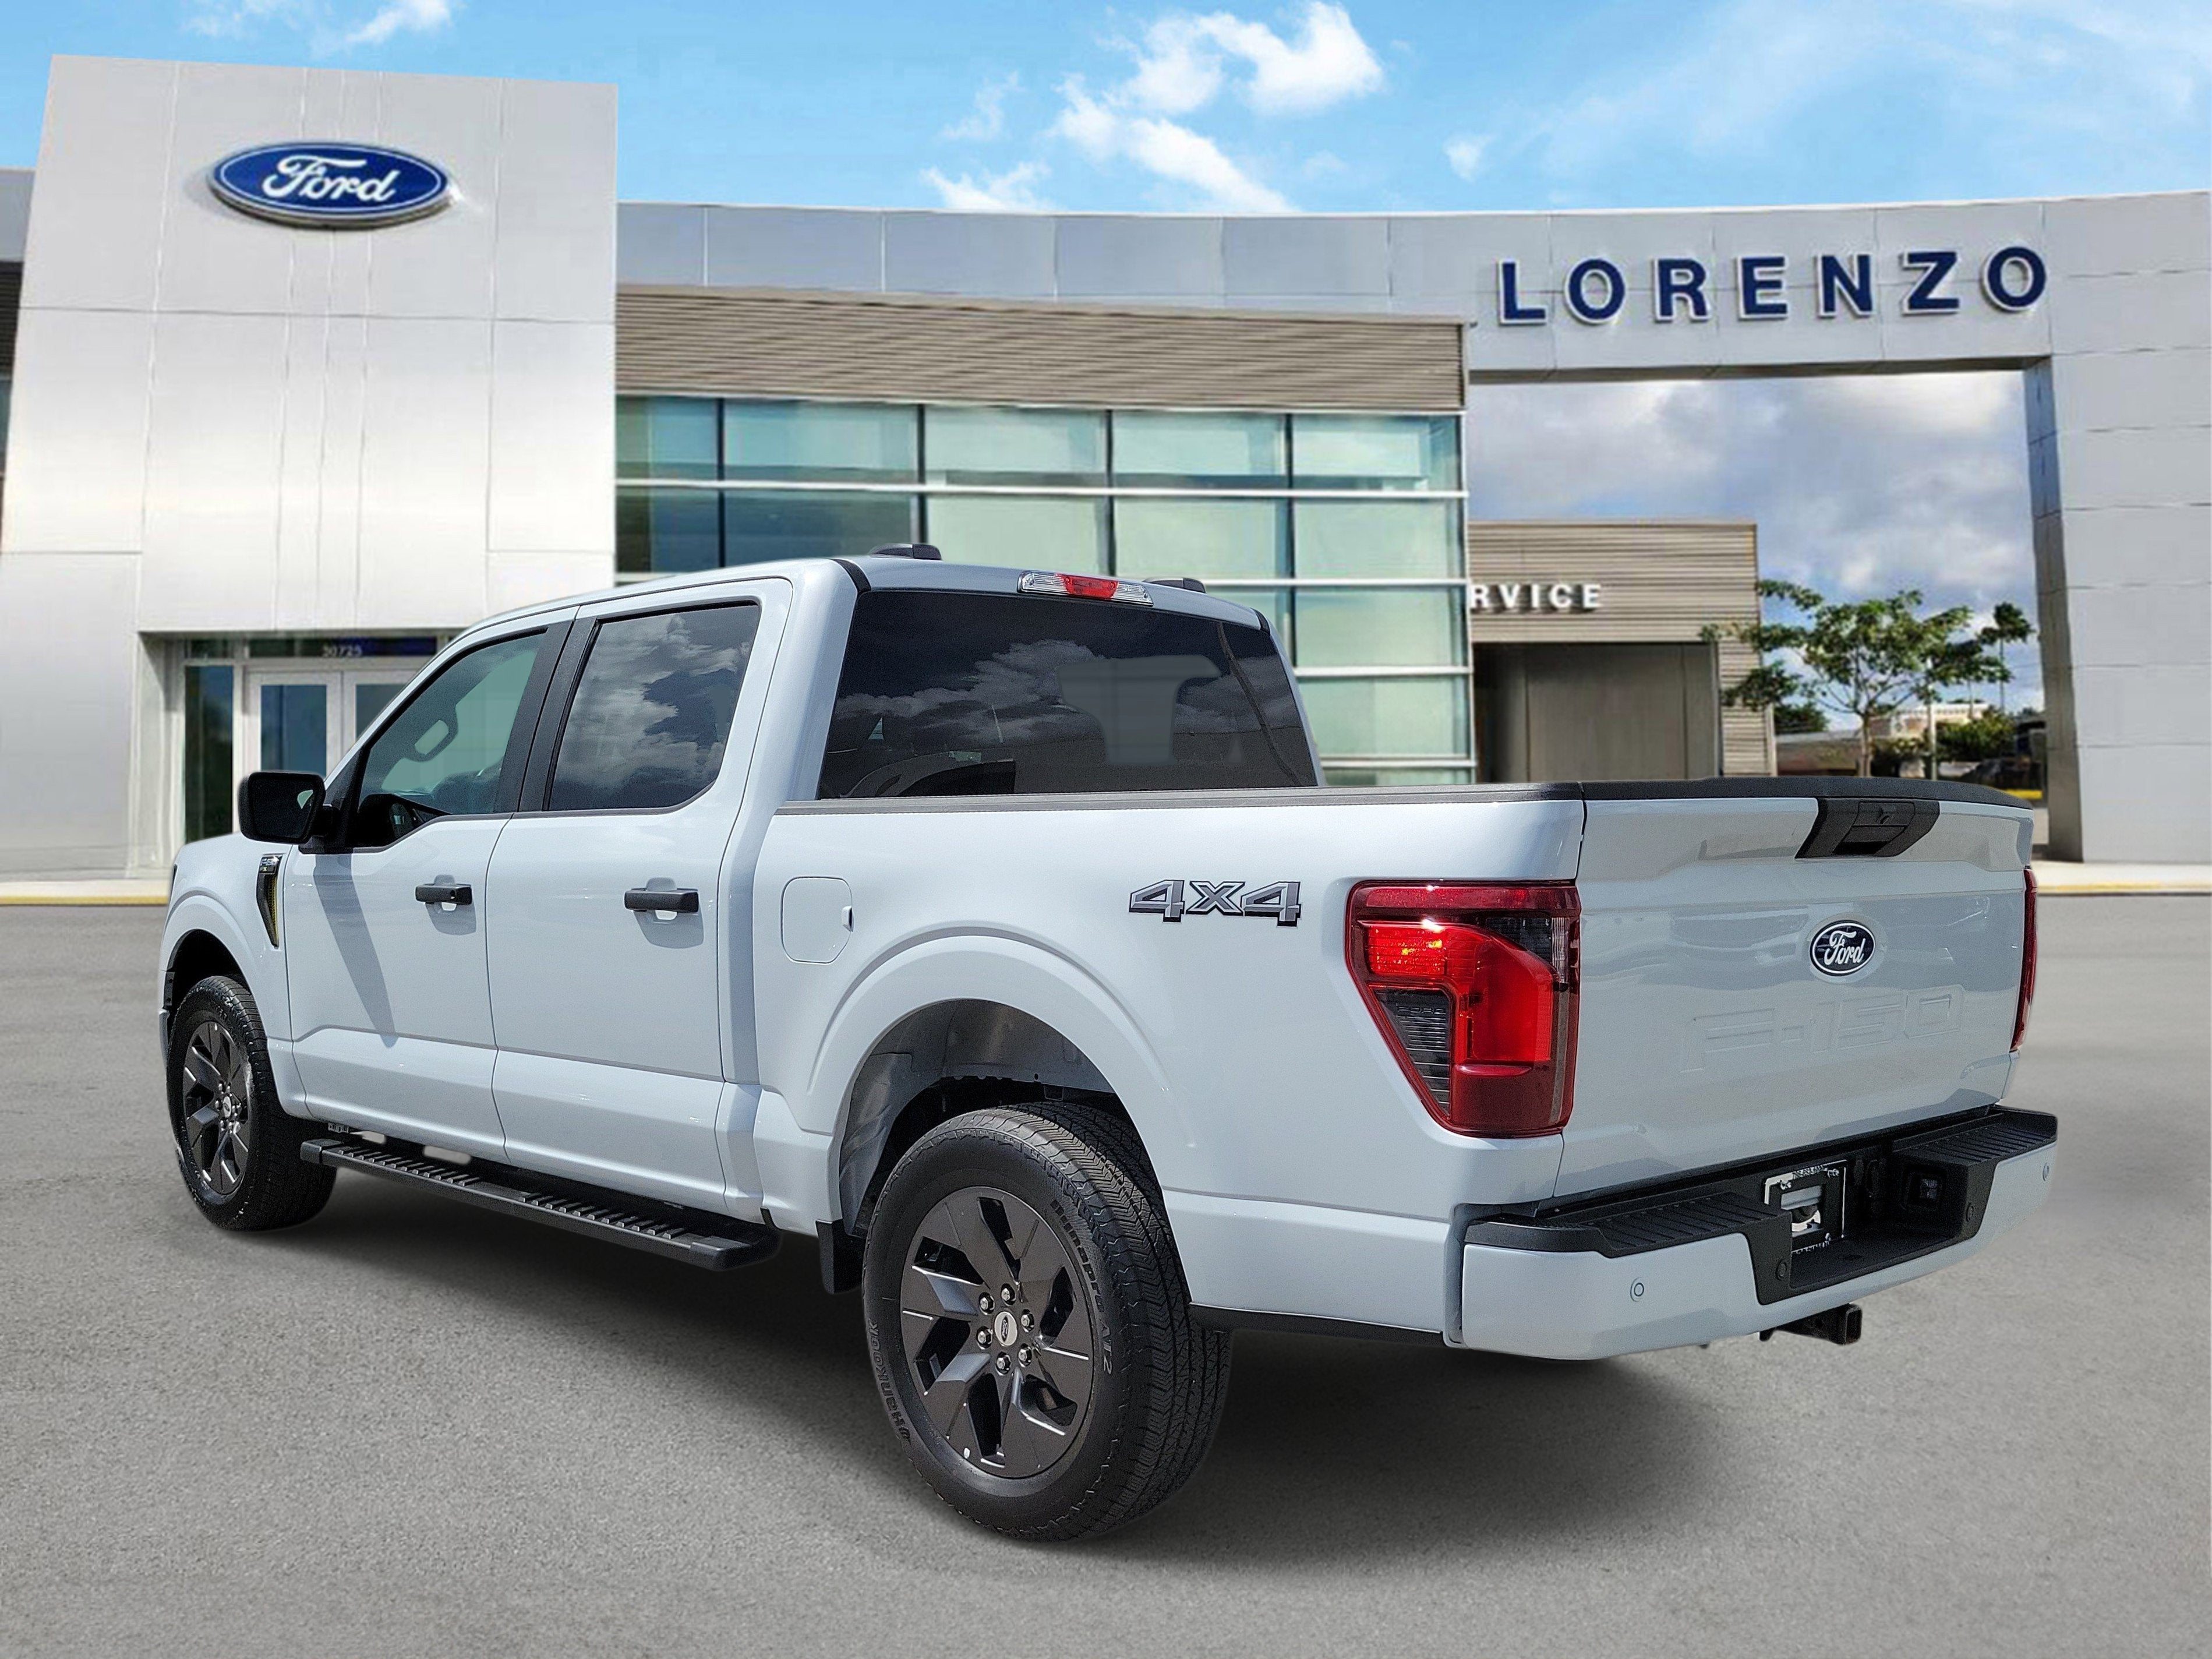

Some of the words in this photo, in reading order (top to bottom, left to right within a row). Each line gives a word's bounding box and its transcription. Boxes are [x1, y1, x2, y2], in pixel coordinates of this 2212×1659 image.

[262, 154, 400, 201] Ford
[1499, 245, 2048, 325] LORENZO
[1129, 880, 1302, 927] 4X4
[1824, 930, 1866, 965] Ford
